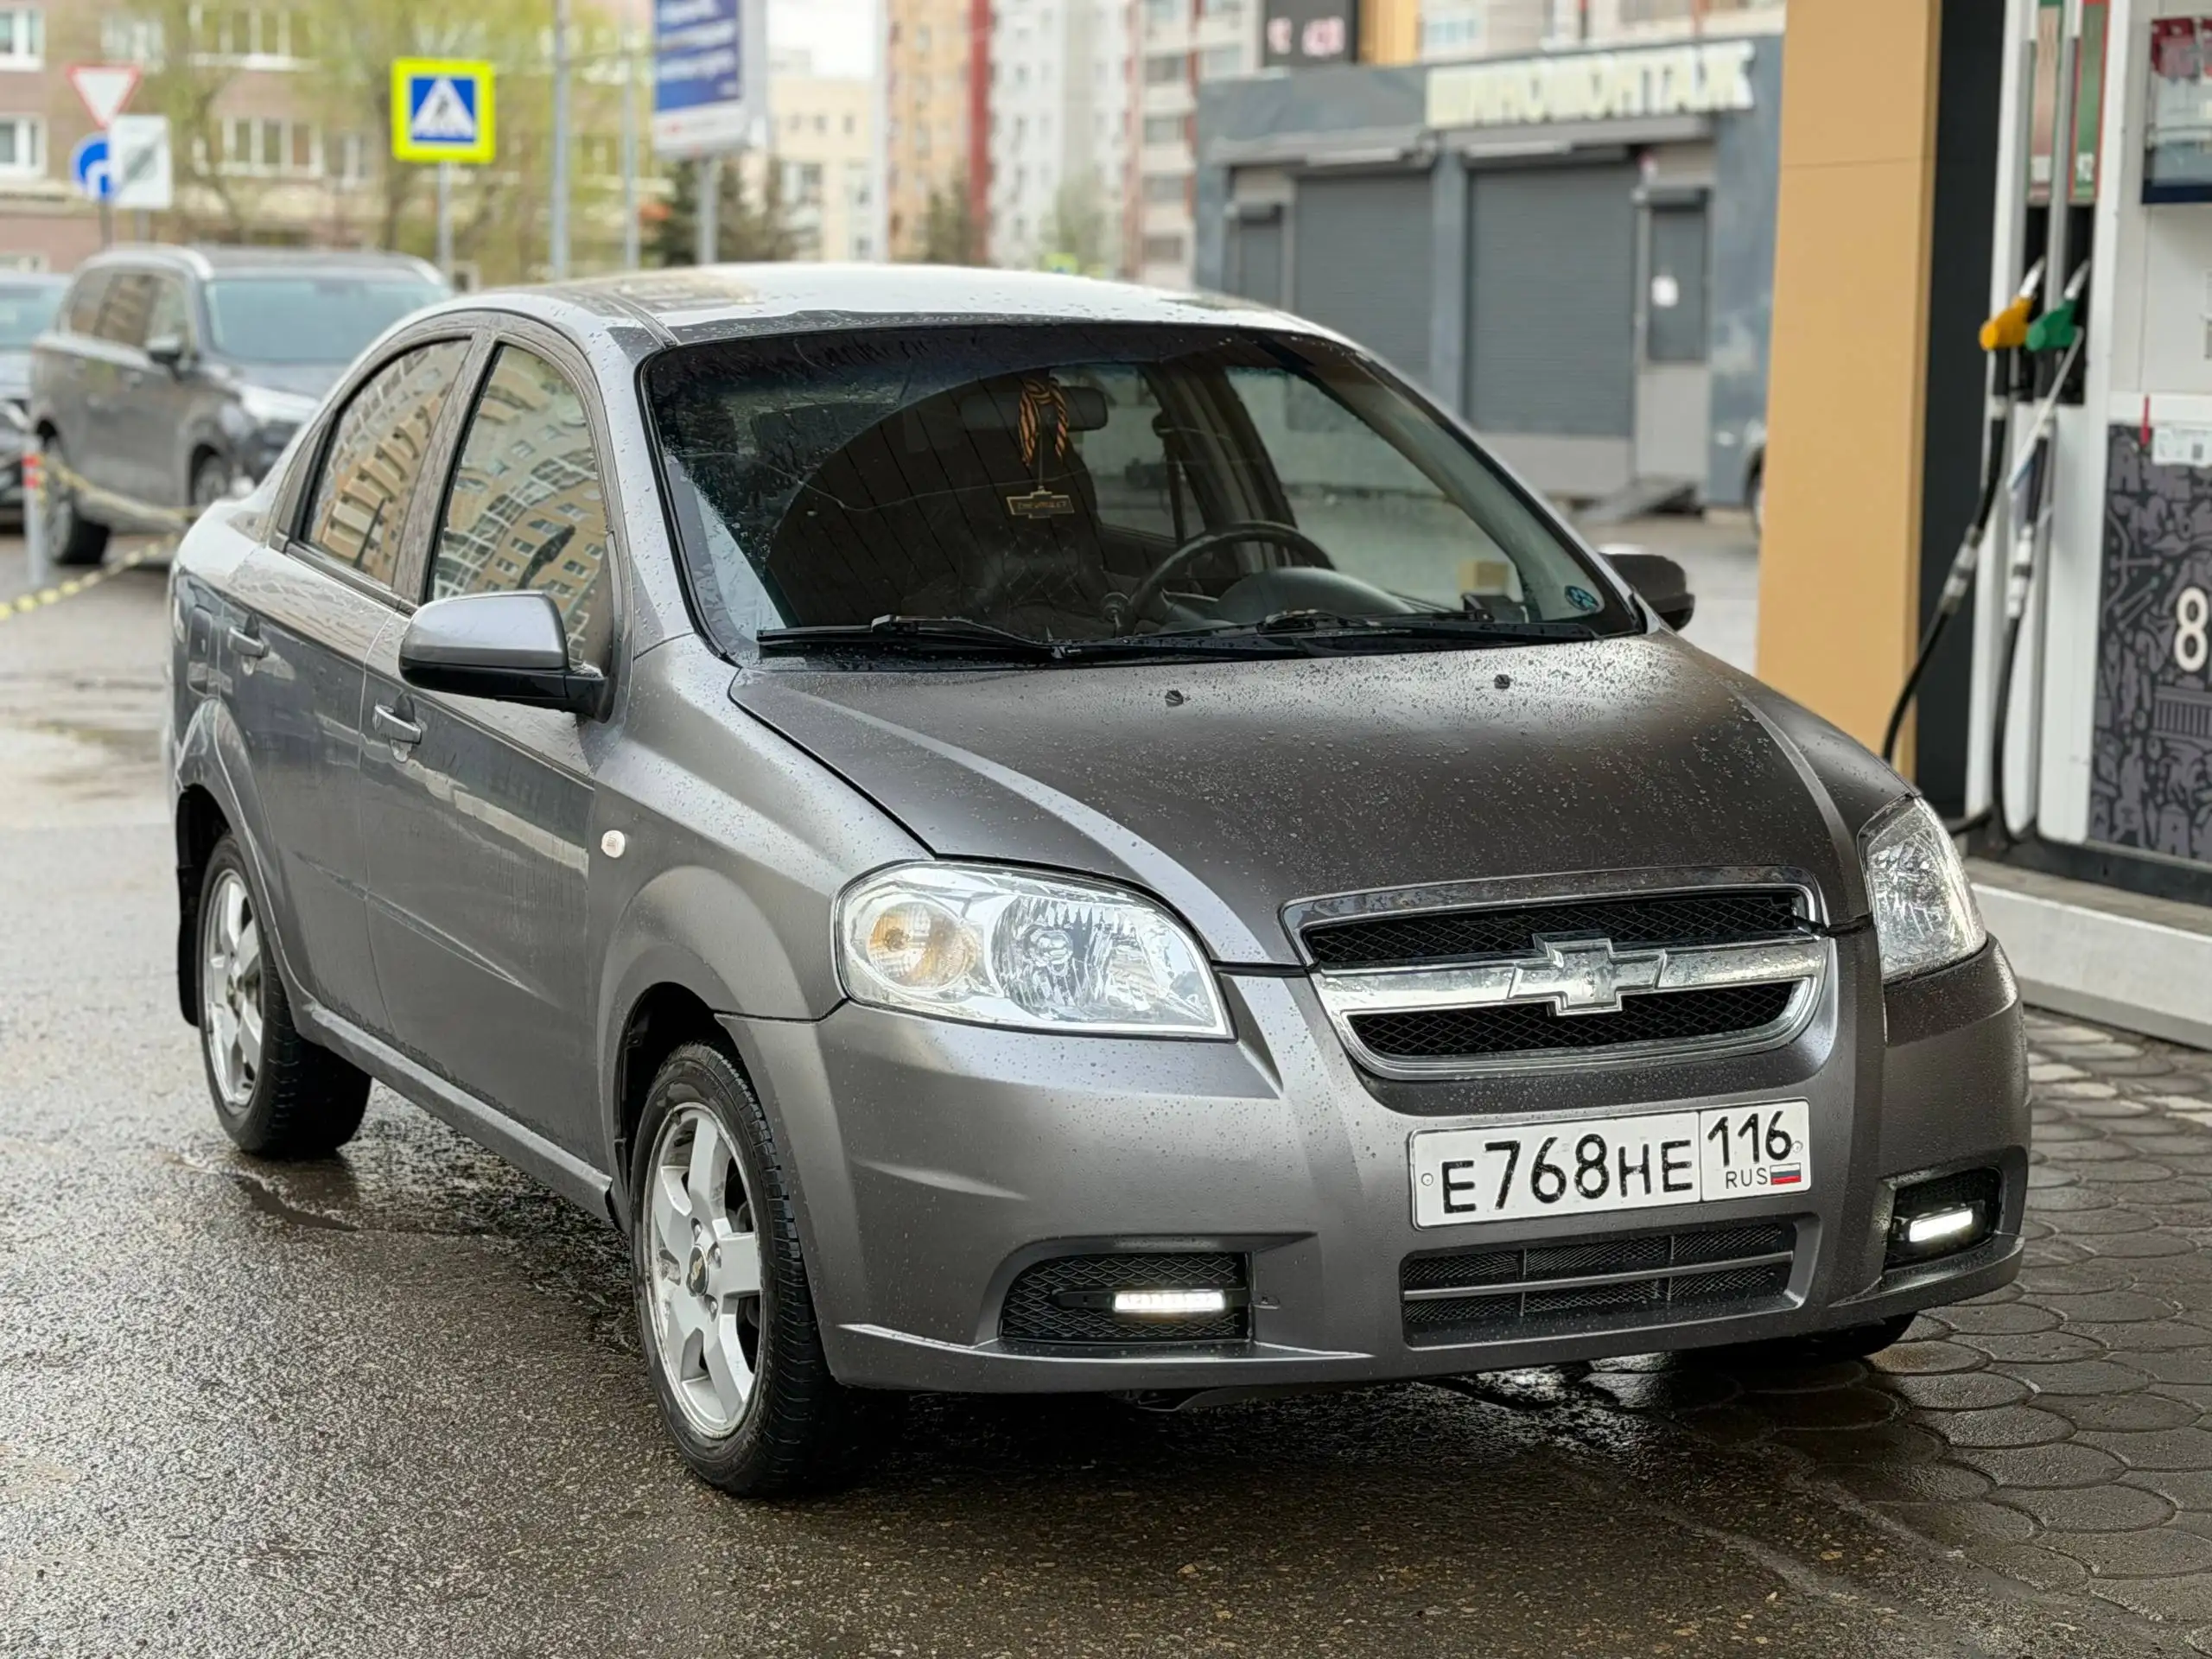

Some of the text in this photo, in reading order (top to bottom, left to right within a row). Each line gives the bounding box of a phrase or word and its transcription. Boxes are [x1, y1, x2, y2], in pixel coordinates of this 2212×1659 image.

[2174, 587, 2209, 672] 8
[1707, 1109, 1793, 1167] 116
[1725, 1166, 1769, 1190] RUS
